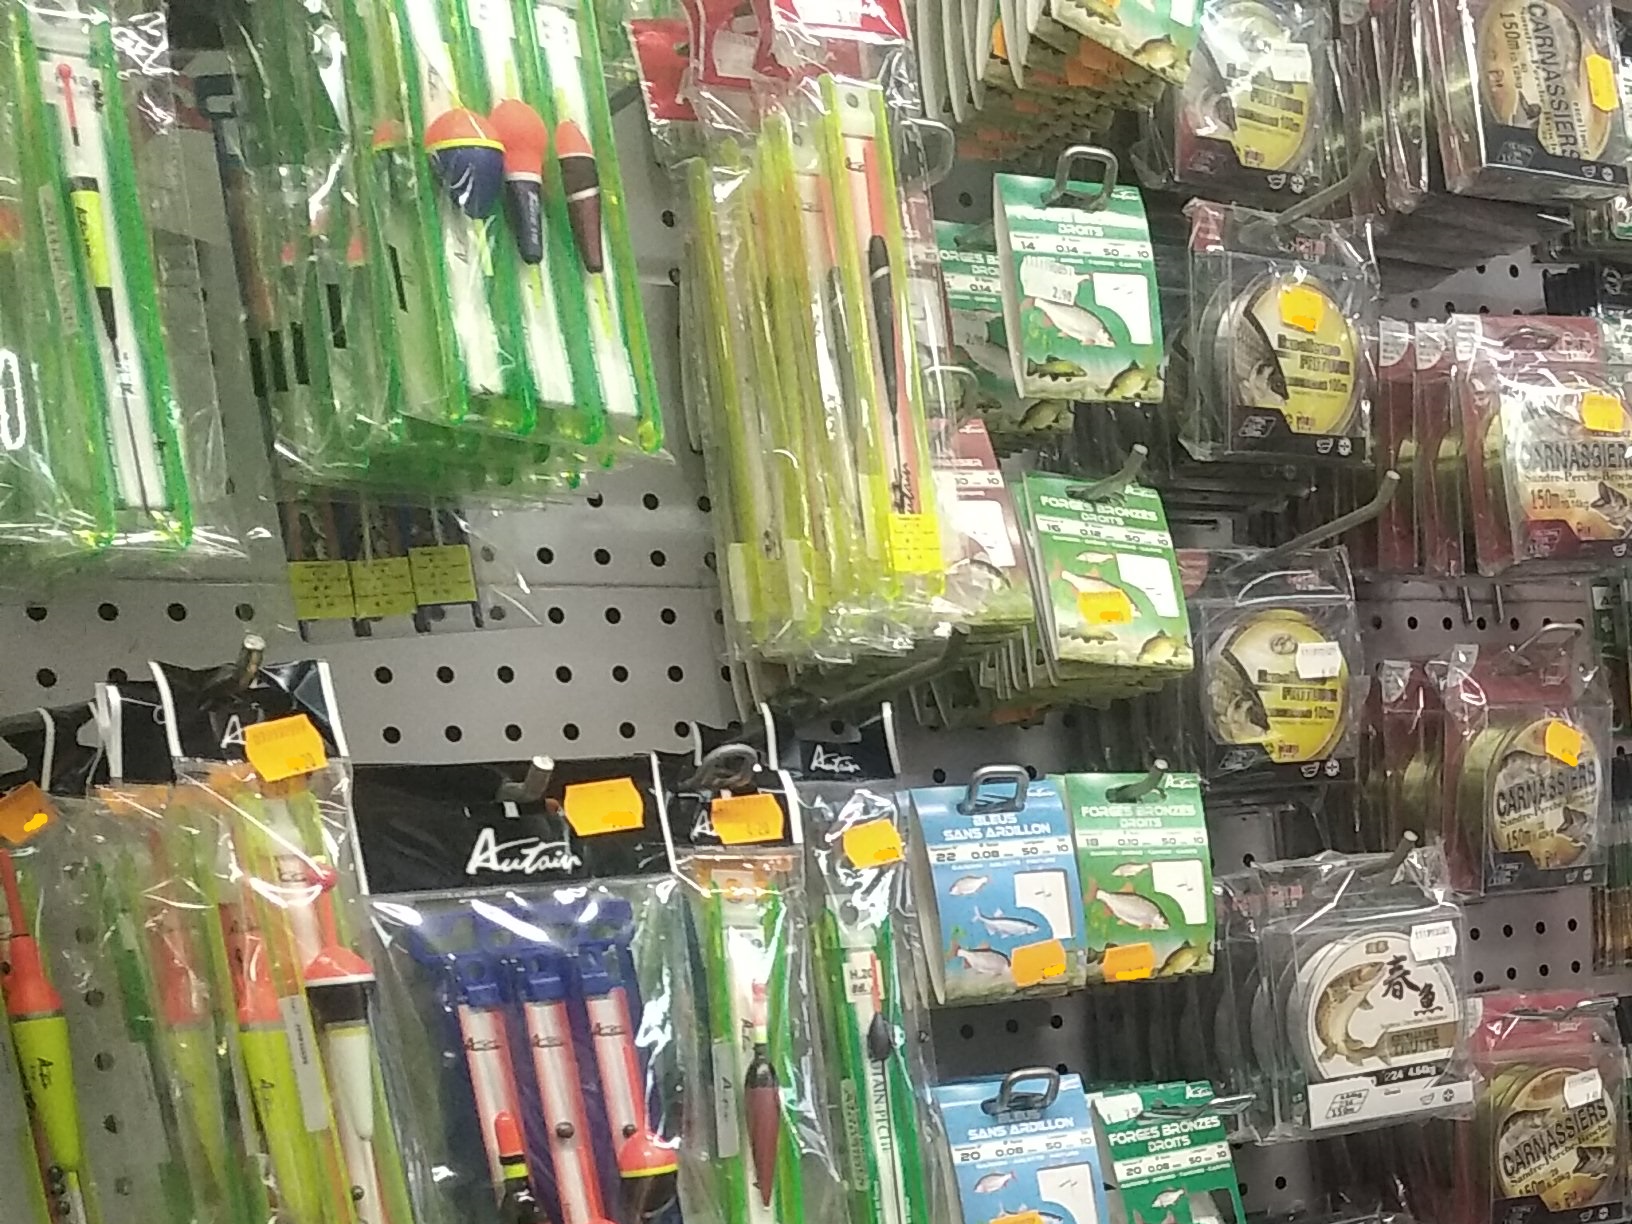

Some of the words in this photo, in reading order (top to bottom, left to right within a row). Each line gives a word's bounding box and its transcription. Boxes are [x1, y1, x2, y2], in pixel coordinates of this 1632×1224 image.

[1040, 496, 1094, 513] FORGES
[1096, 503, 1157, 522] BRONZES
[972, 813, 1017, 826] BLEUS
[1081, 805, 1132, 817] FORGES
[1135, 805, 1196, 817] BRONZES
[943, 828, 983, 841] SANS
[985, 822, 1051, 840] ARDILLON
[1120, 817, 1162, 828] DROITS
[465, 826, 583, 877] Autain
[936, 852, 956, 862] 22
[968, 1126, 1008, 1140] SANS
[1010, 1117, 1075, 1135] ARDILLON
[1107, 1126, 1160, 1146] FORGES
[1162, 1116, 1221, 1134] BRONZES
[1148, 1135, 1191, 1153] DROITS
[1502, 1101, 1609, 1178] CARNASSIERS
[960, 1151, 981, 1162] 20
[1046, 1141, 1062, 1150] 50
[1127, 1167, 1141, 1176] 20
